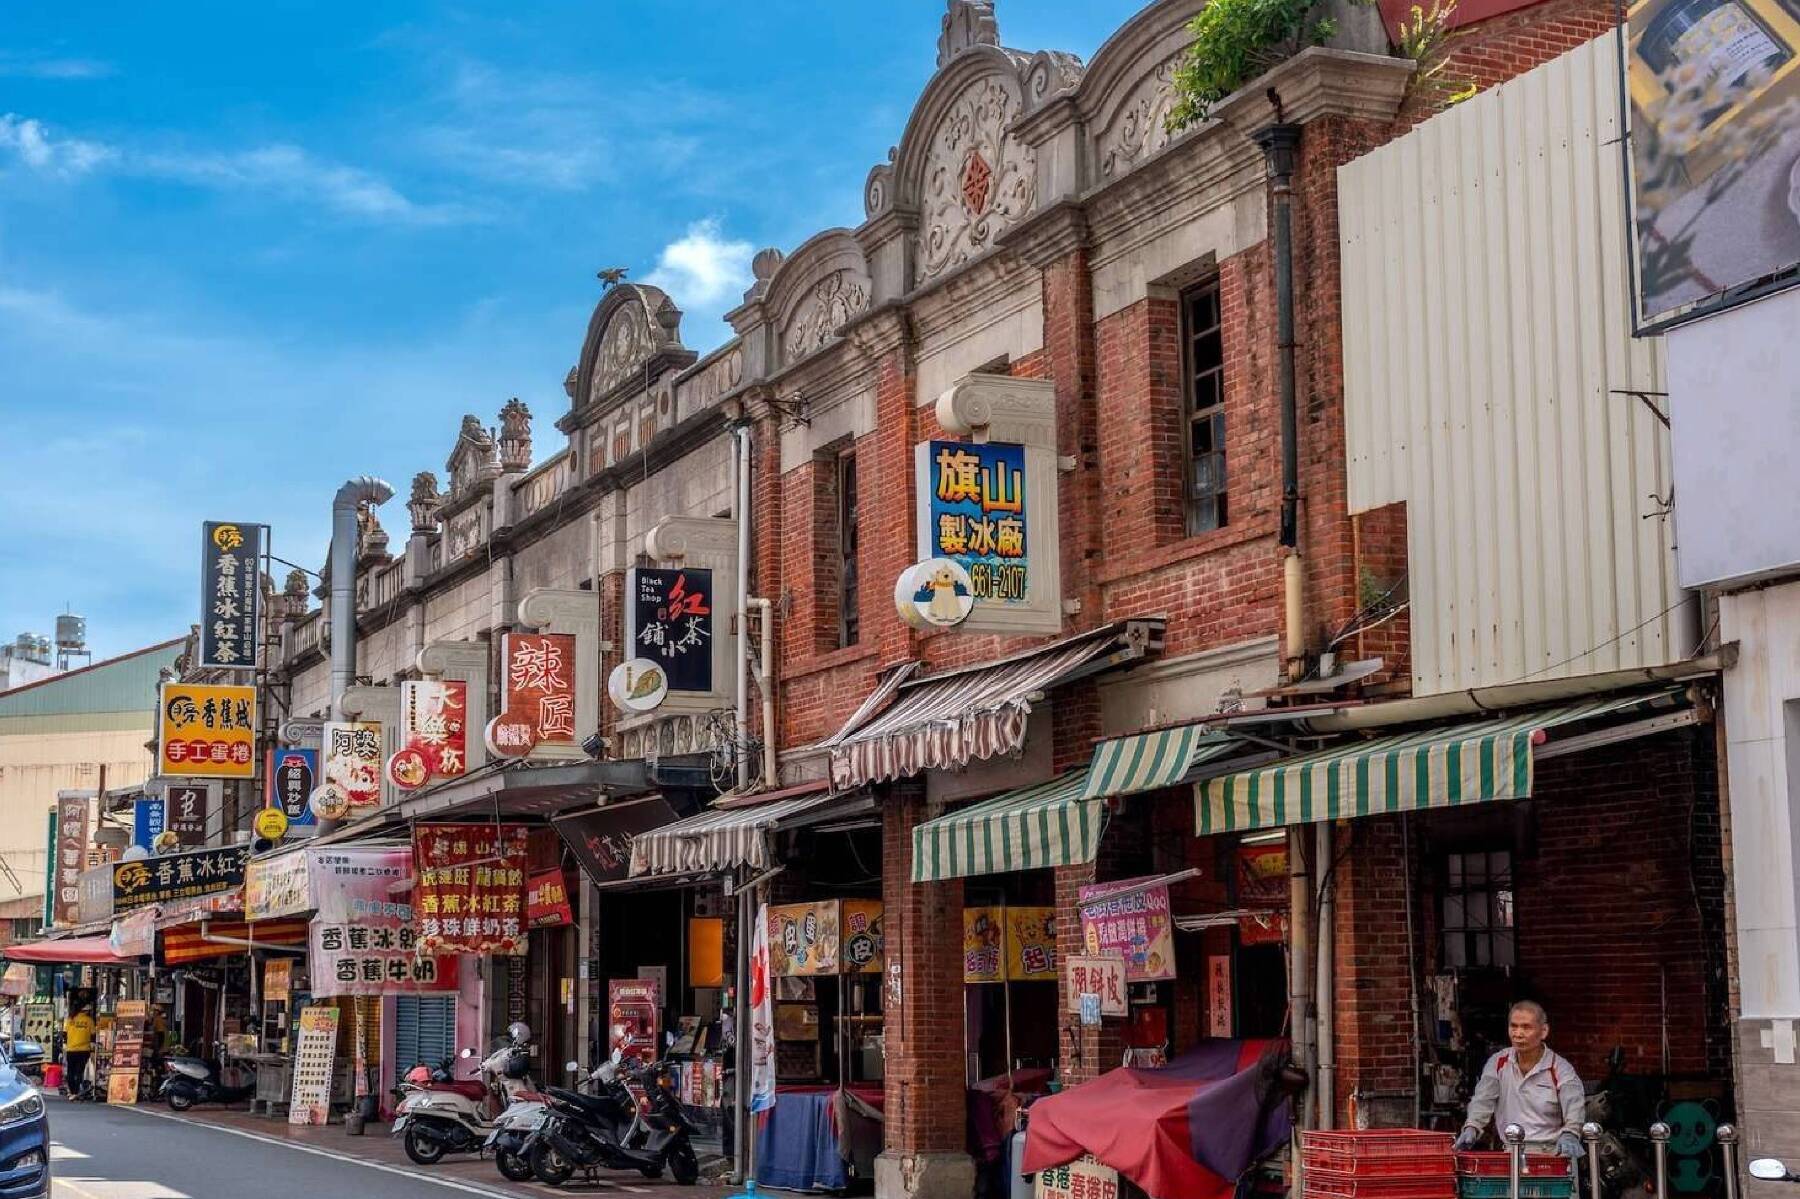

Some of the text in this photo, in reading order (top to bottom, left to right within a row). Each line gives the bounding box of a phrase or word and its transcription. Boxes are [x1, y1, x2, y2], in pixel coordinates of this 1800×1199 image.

[937, 449, 1022, 514] 旗山
[939, 515, 1023, 557] 製冰廠
[641, 577, 662, 586] Black
[641, 585, 654, 594] Tea
[971, 565, 1025, 598] 661-2107
[641, 594, 661, 603] Shop
[214, 554, 240, 663] 香蕉冰紅茶
[167, 743, 250, 762] 手工蛋捲
[422, 894, 520, 913] 香蕉冰紅茶
[422, 918, 519, 936] 珍珠鮮奶茶
[336, 959, 434, 981] 香蕉牛奶
